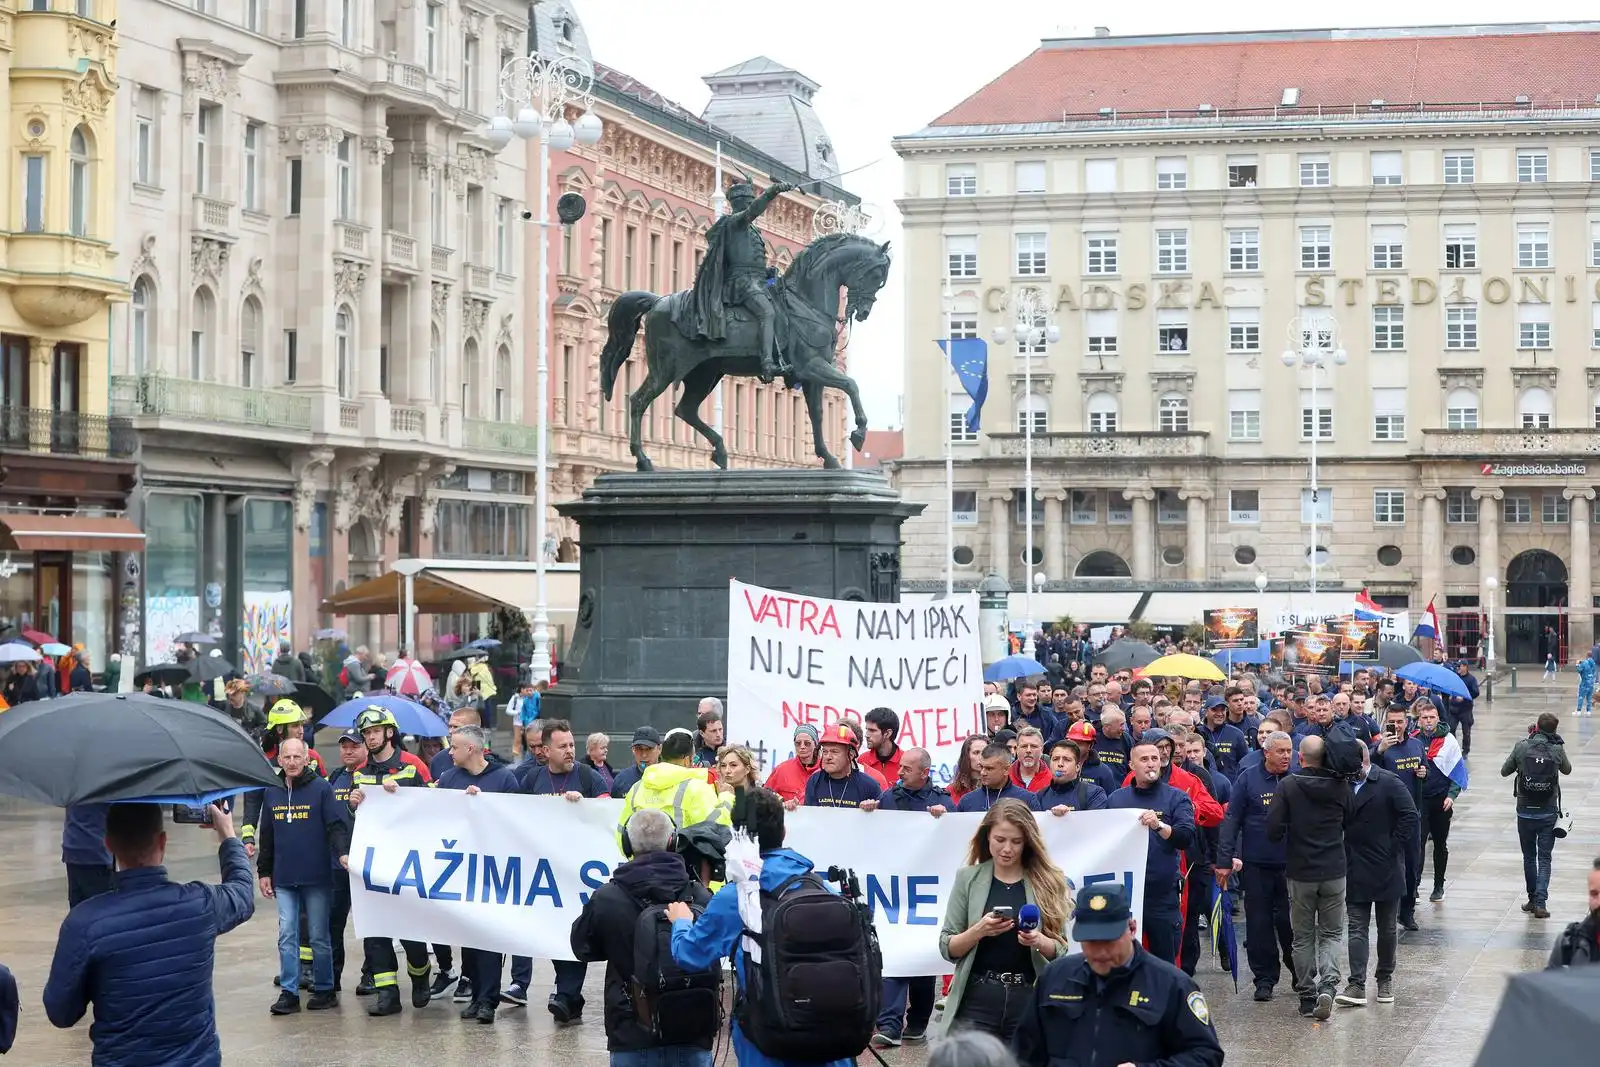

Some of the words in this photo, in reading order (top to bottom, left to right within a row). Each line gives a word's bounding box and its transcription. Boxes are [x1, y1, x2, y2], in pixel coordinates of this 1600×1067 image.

[1494, 463, 1552, 477] Zagrebačka
[1555, 463, 1586, 475] banka
[744, 589, 842, 638] VATRA
[856, 607, 915, 640] NAM
[924, 604, 971, 638] IPAK
[750, 636, 825, 685] NIJE
[848, 648, 967, 690] NAJVEĆI
[274, 812, 284, 820] NE
[286, 811, 309, 819] ASE
[362, 839, 564, 908] LAŽIMA
[866, 874, 939, 926] NE
